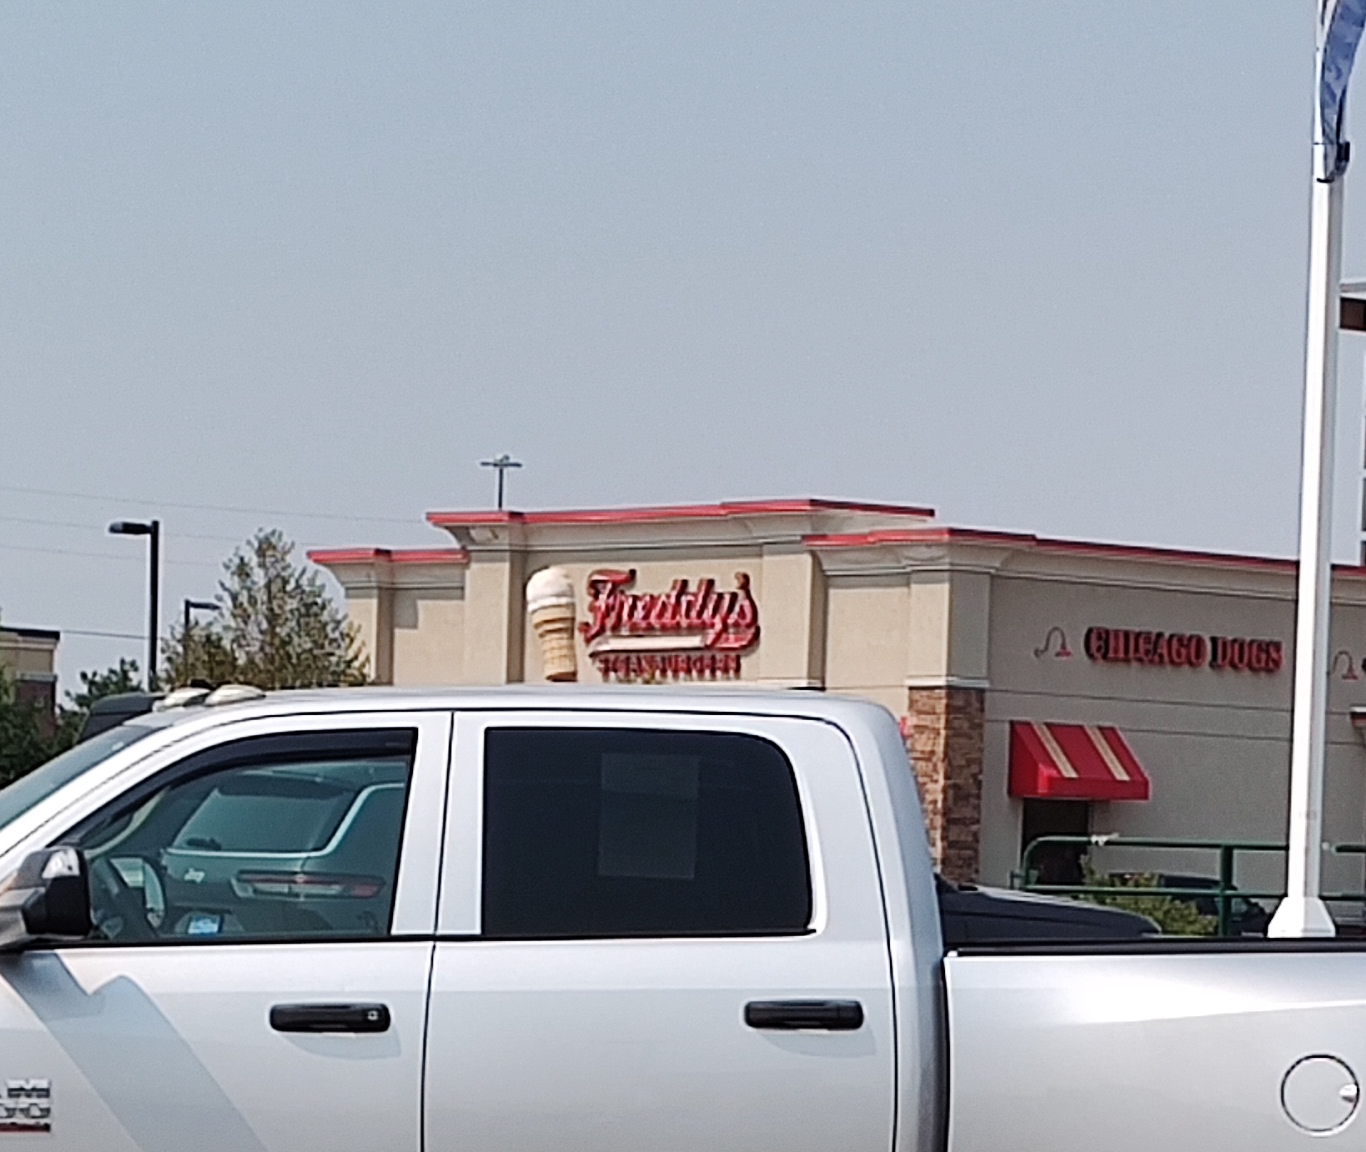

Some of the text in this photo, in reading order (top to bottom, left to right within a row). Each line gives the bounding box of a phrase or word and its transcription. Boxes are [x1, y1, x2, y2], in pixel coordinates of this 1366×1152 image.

[578, 568, 761, 648] Freddy's
[1084, 626, 1284, 673] CHICAGO DOGS
